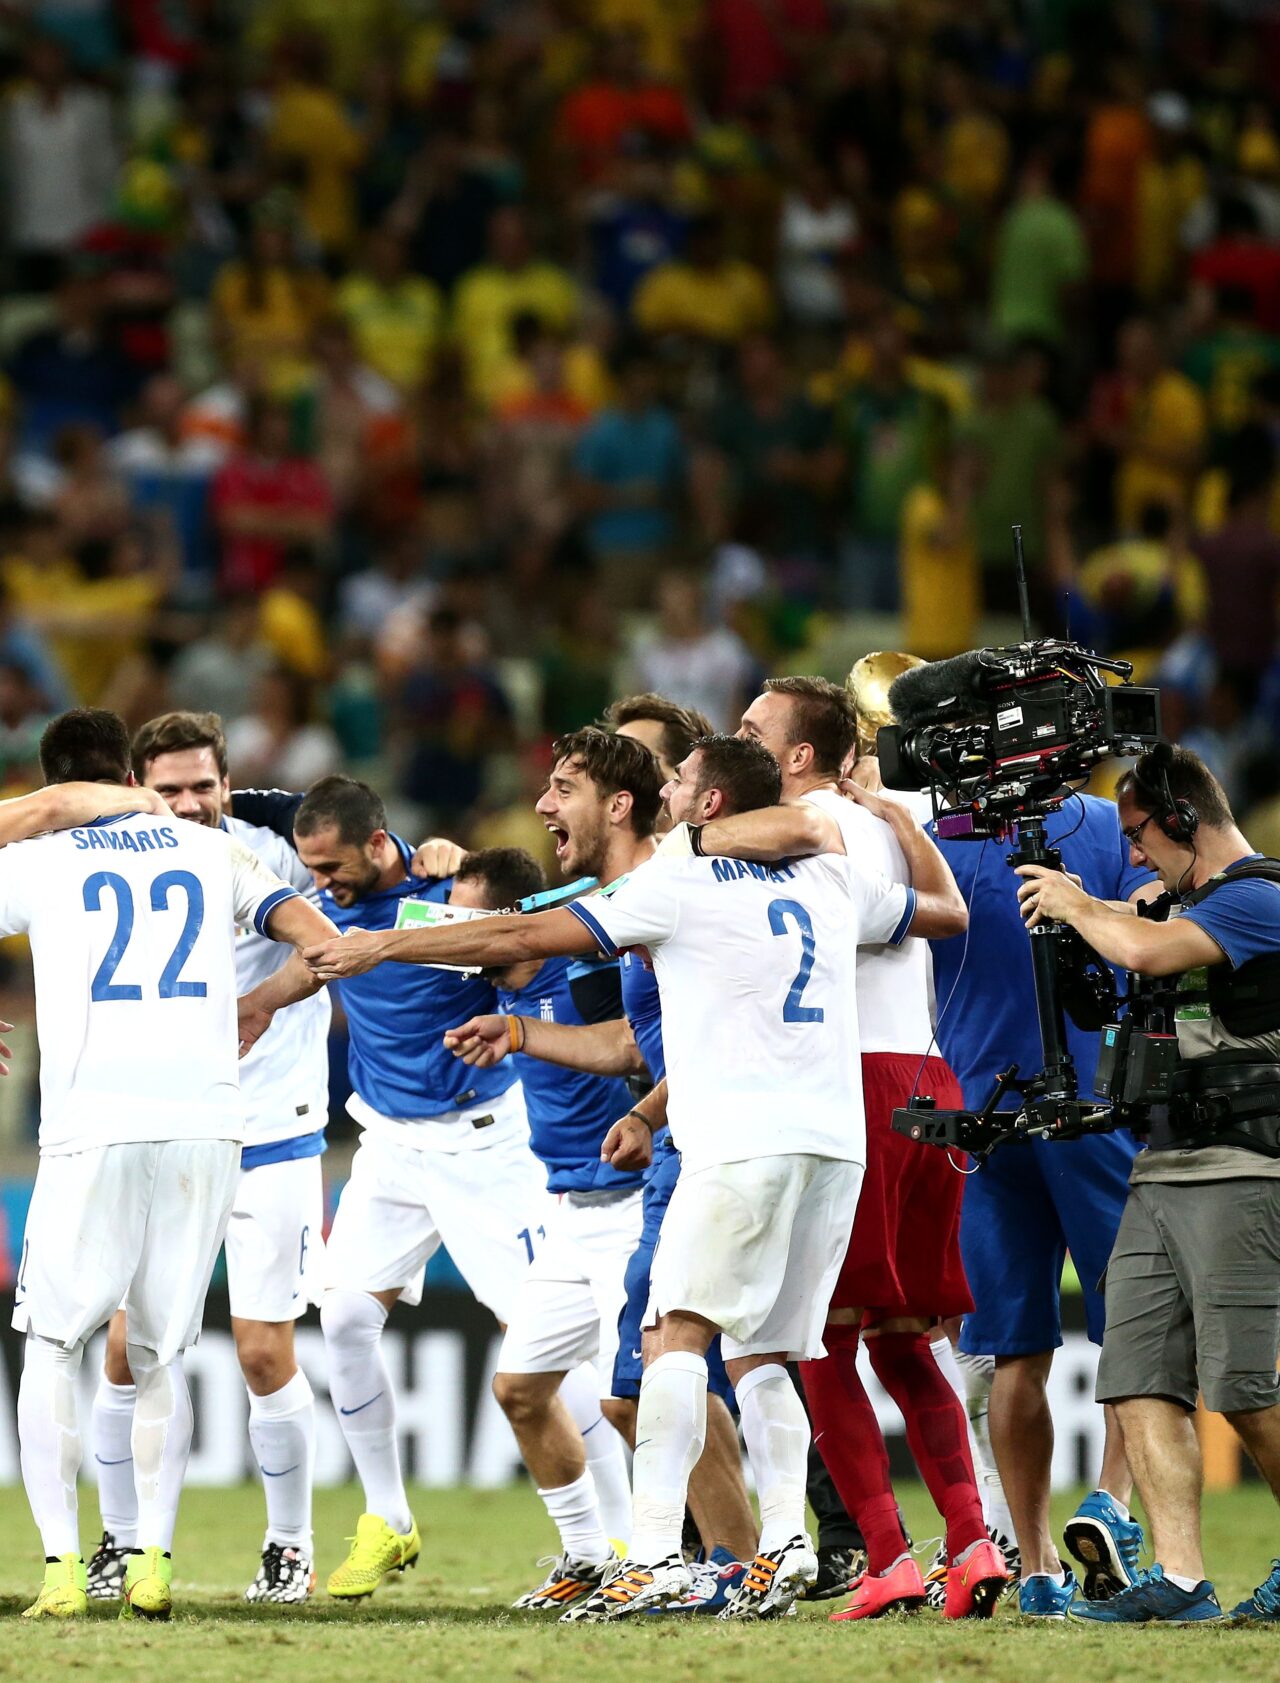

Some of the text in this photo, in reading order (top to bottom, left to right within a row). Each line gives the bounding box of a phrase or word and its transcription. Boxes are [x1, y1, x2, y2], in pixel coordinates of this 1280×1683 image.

[70, 827, 179, 852] SAMARIS
[82, 869, 208, 1002] 22
[767, 898, 825, 1023] 2
